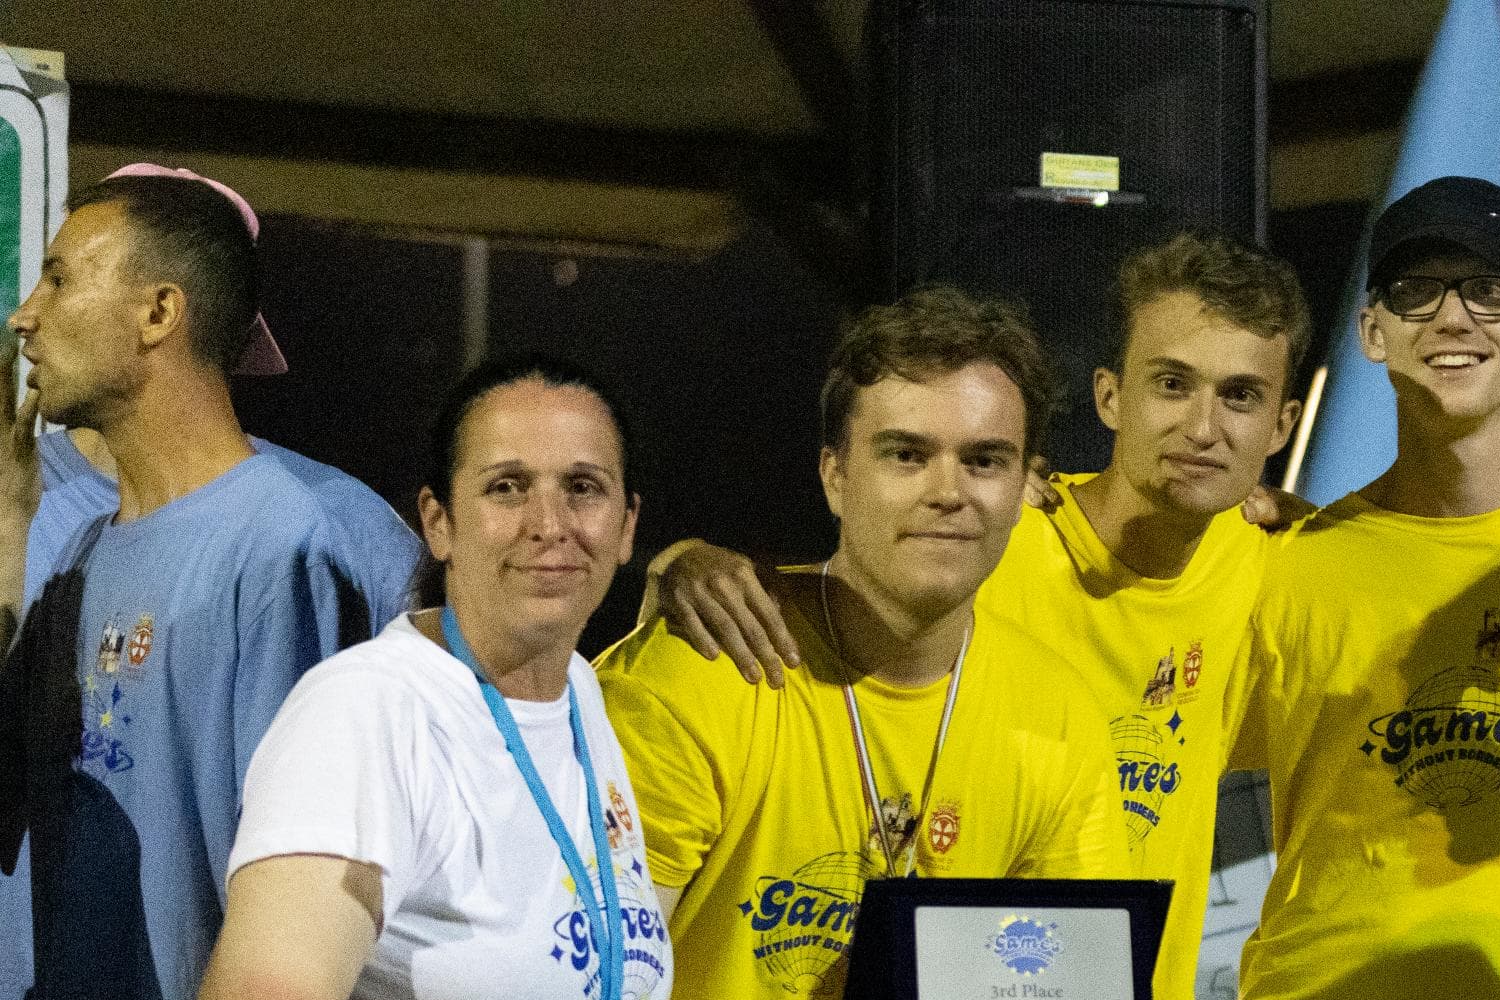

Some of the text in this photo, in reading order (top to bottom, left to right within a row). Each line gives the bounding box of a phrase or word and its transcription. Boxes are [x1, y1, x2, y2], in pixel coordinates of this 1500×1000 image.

[751, 879, 861, 934] Gam
[753, 934, 822, 960] WITHOUT
[991, 983, 1065, 999] 3rd Place
